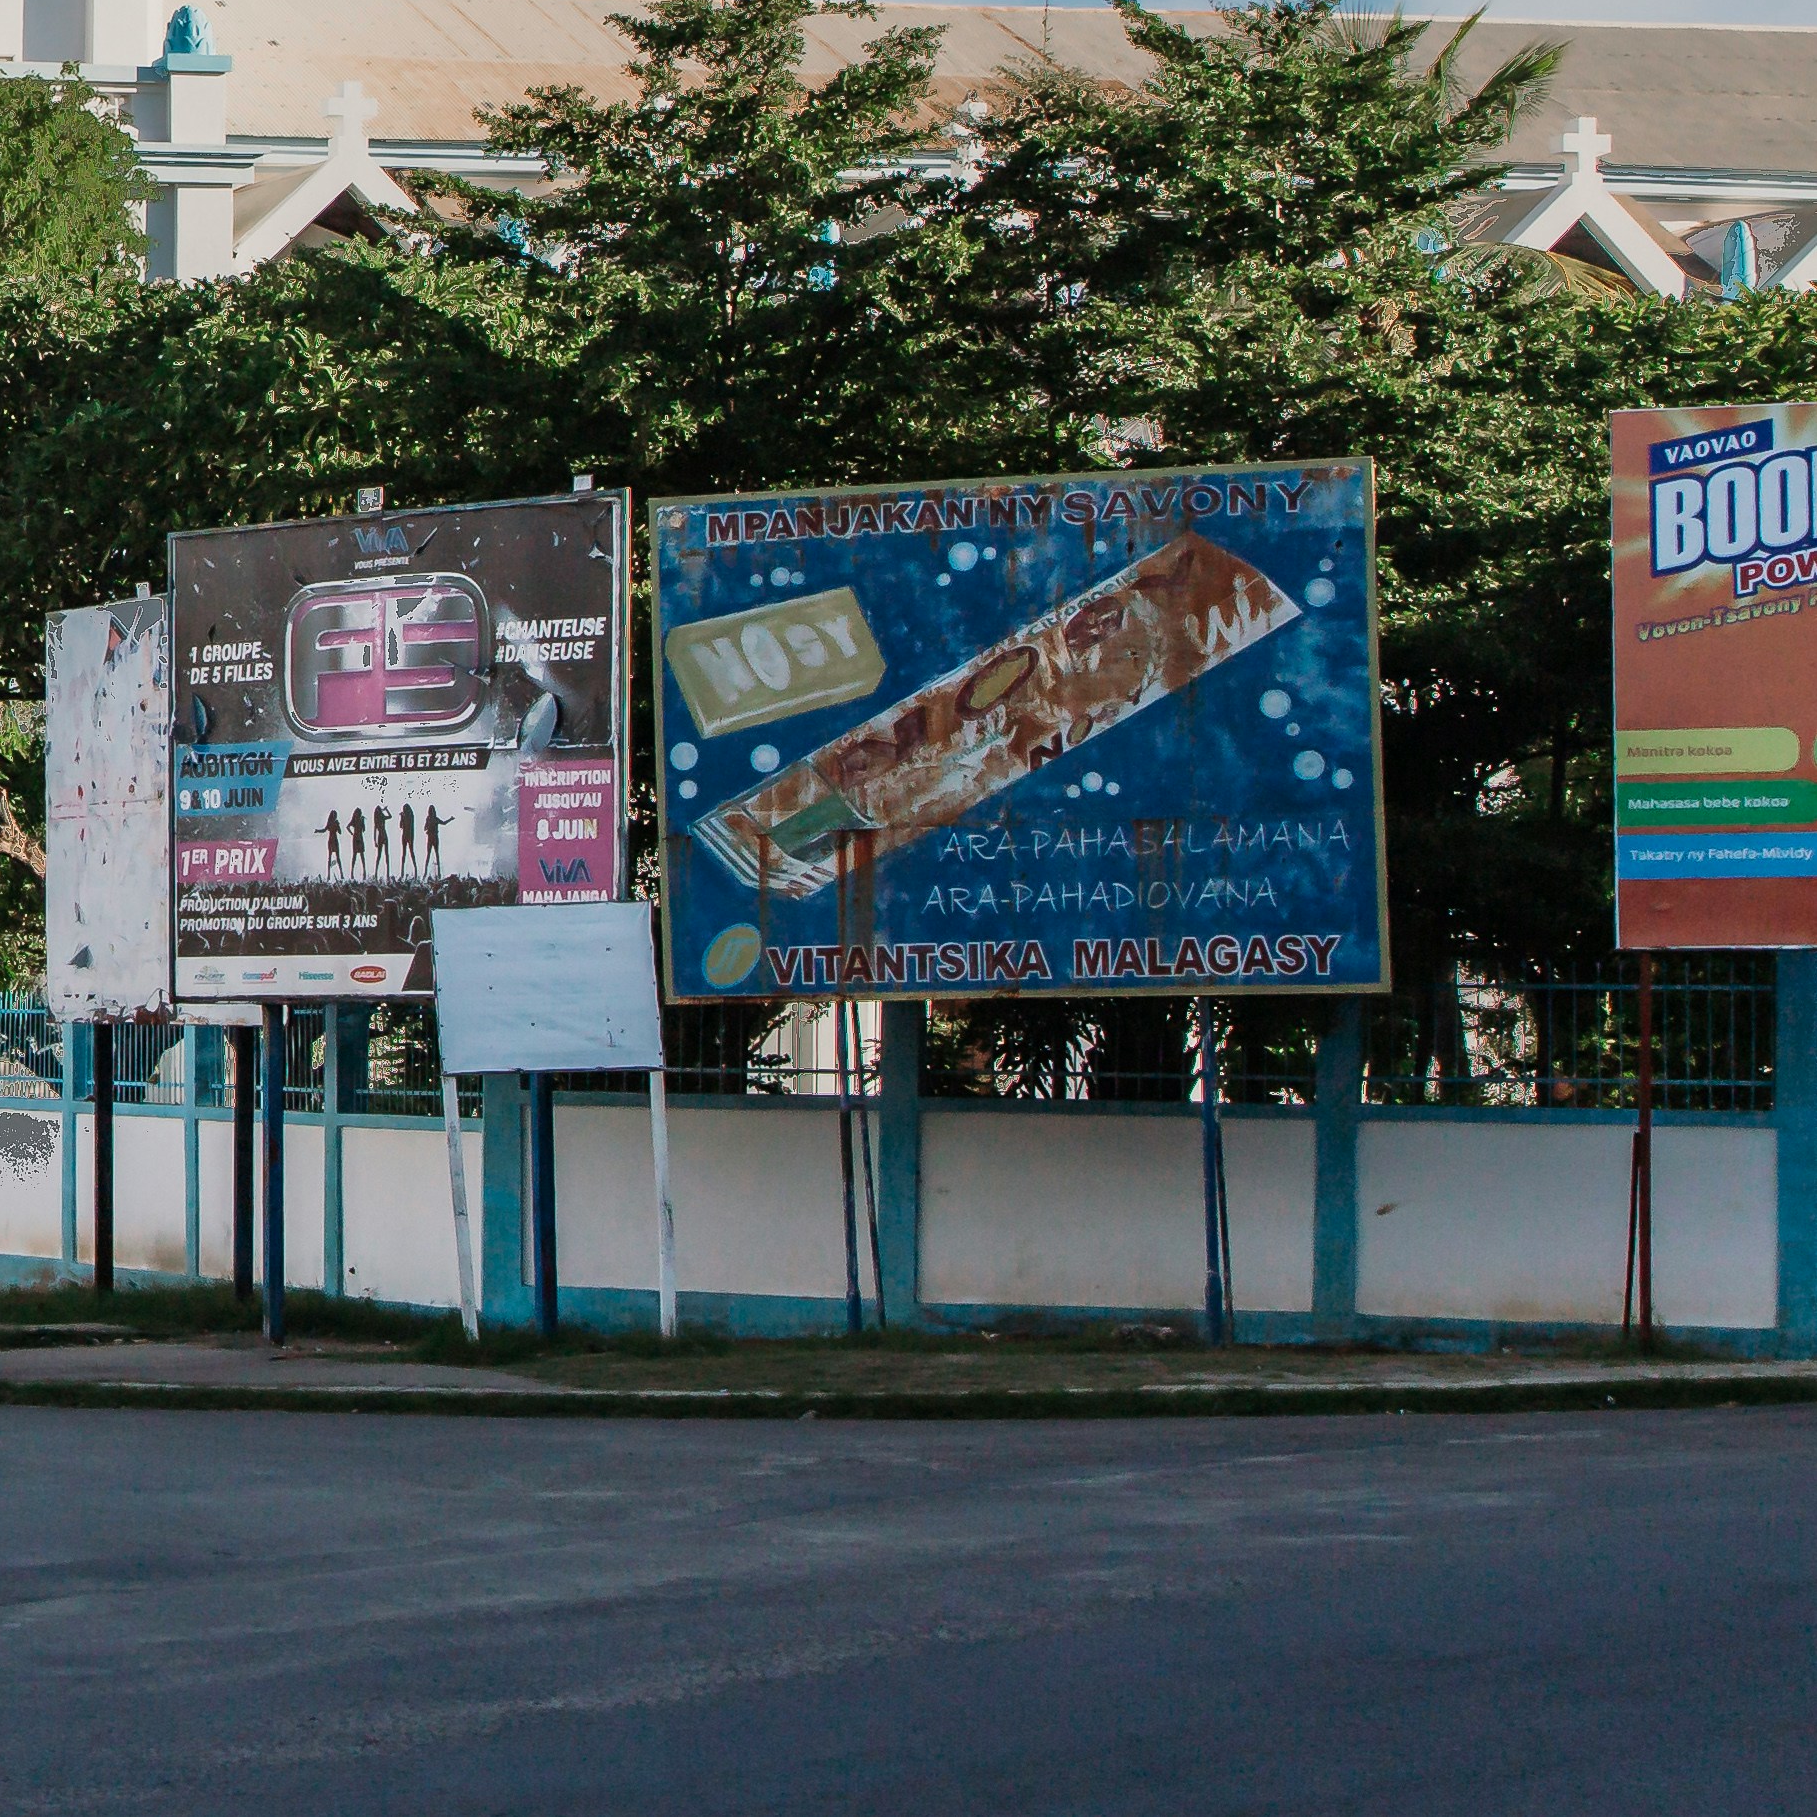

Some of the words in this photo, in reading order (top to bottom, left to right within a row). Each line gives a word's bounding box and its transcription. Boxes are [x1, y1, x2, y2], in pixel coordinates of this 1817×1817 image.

[1665, 431, 1757, 464] VAOVAO
[706, 494, 1053, 547] MPANJAKAN'NY
[1061, 481, 1313, 525] SAVONY
[1653, 450, 1817, 573] BOO
[202, 642, 262, 663] GROUPE
[688, 613, 859, 705] NOSY
[190, 667, 208, 684] DE
[212, 666, 221, 683] 5
[224, 663, 274, 682] FILLES
[293, 759, 324, 774] VOUS
[327, 757, 356, 772] AVEZ
[359, 756, 396, 771] ENTRE
[400, 754, 414, 769] 16
[417, 754, 431, 768] ET
[435, 753, 449, 767] 23
[452, 752, 477, 767] ANS
[524, 769, 611, 787] INSCRIPTION
[224, 787, 264, 809] JUIN
[534, 792, 602, 810] JUSQU'AU
[1703, 796, 1740, 809] bebe
[552, 818, 598, 841] JUIN
[181, 848, 208, 877] 1ER
[214, 847, 269, 875] PRIX
[180, 896, 250, 913] PRODUCTION
[252, 896, 303, 912] D'ALBUM
[180, 916, 245, 932] PROMOTION
[247, 916, 264, 930] DU
[266, 915, 314, 930] GROUPE
[316, 915, 339, 929] SUR
[342, 914, 351, 929] 3
[353, 914, 378, 928] ANS
[766, 940, 1052, 985] VITANTSIKA
[1072, 934, 1341, 979] MALAGASY
